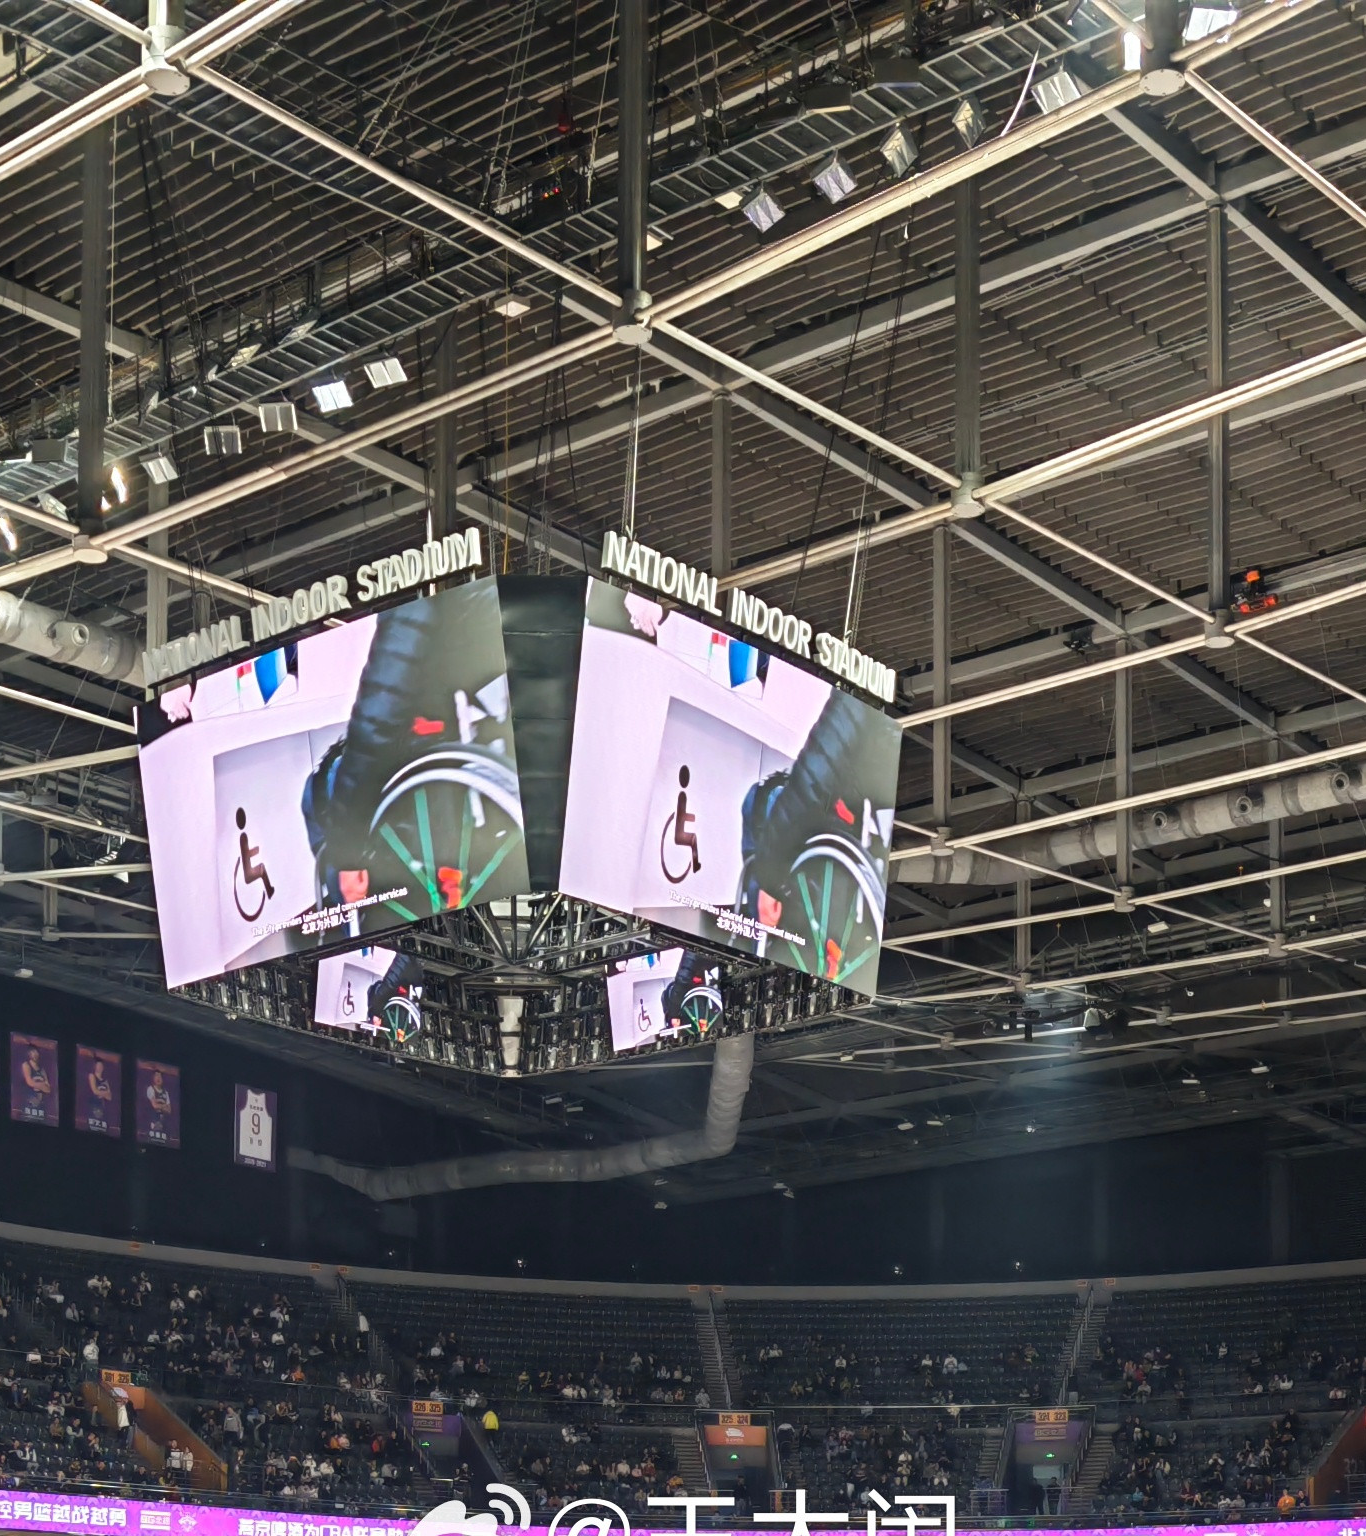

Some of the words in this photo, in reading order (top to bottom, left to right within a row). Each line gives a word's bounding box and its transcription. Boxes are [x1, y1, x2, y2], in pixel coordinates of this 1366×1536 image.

[143, 617, 250, 689] NATIONAL
[251, 574, 350, 643] INDOOR
[356, 526, 483, 602] STADIUM
[601, 530, 723, 617] NATIONAL
[727, 586, 812, 659] INDOOR
[813, 632, 897, 703] STADIUM
[251, 1114, 260, 1136] 9
